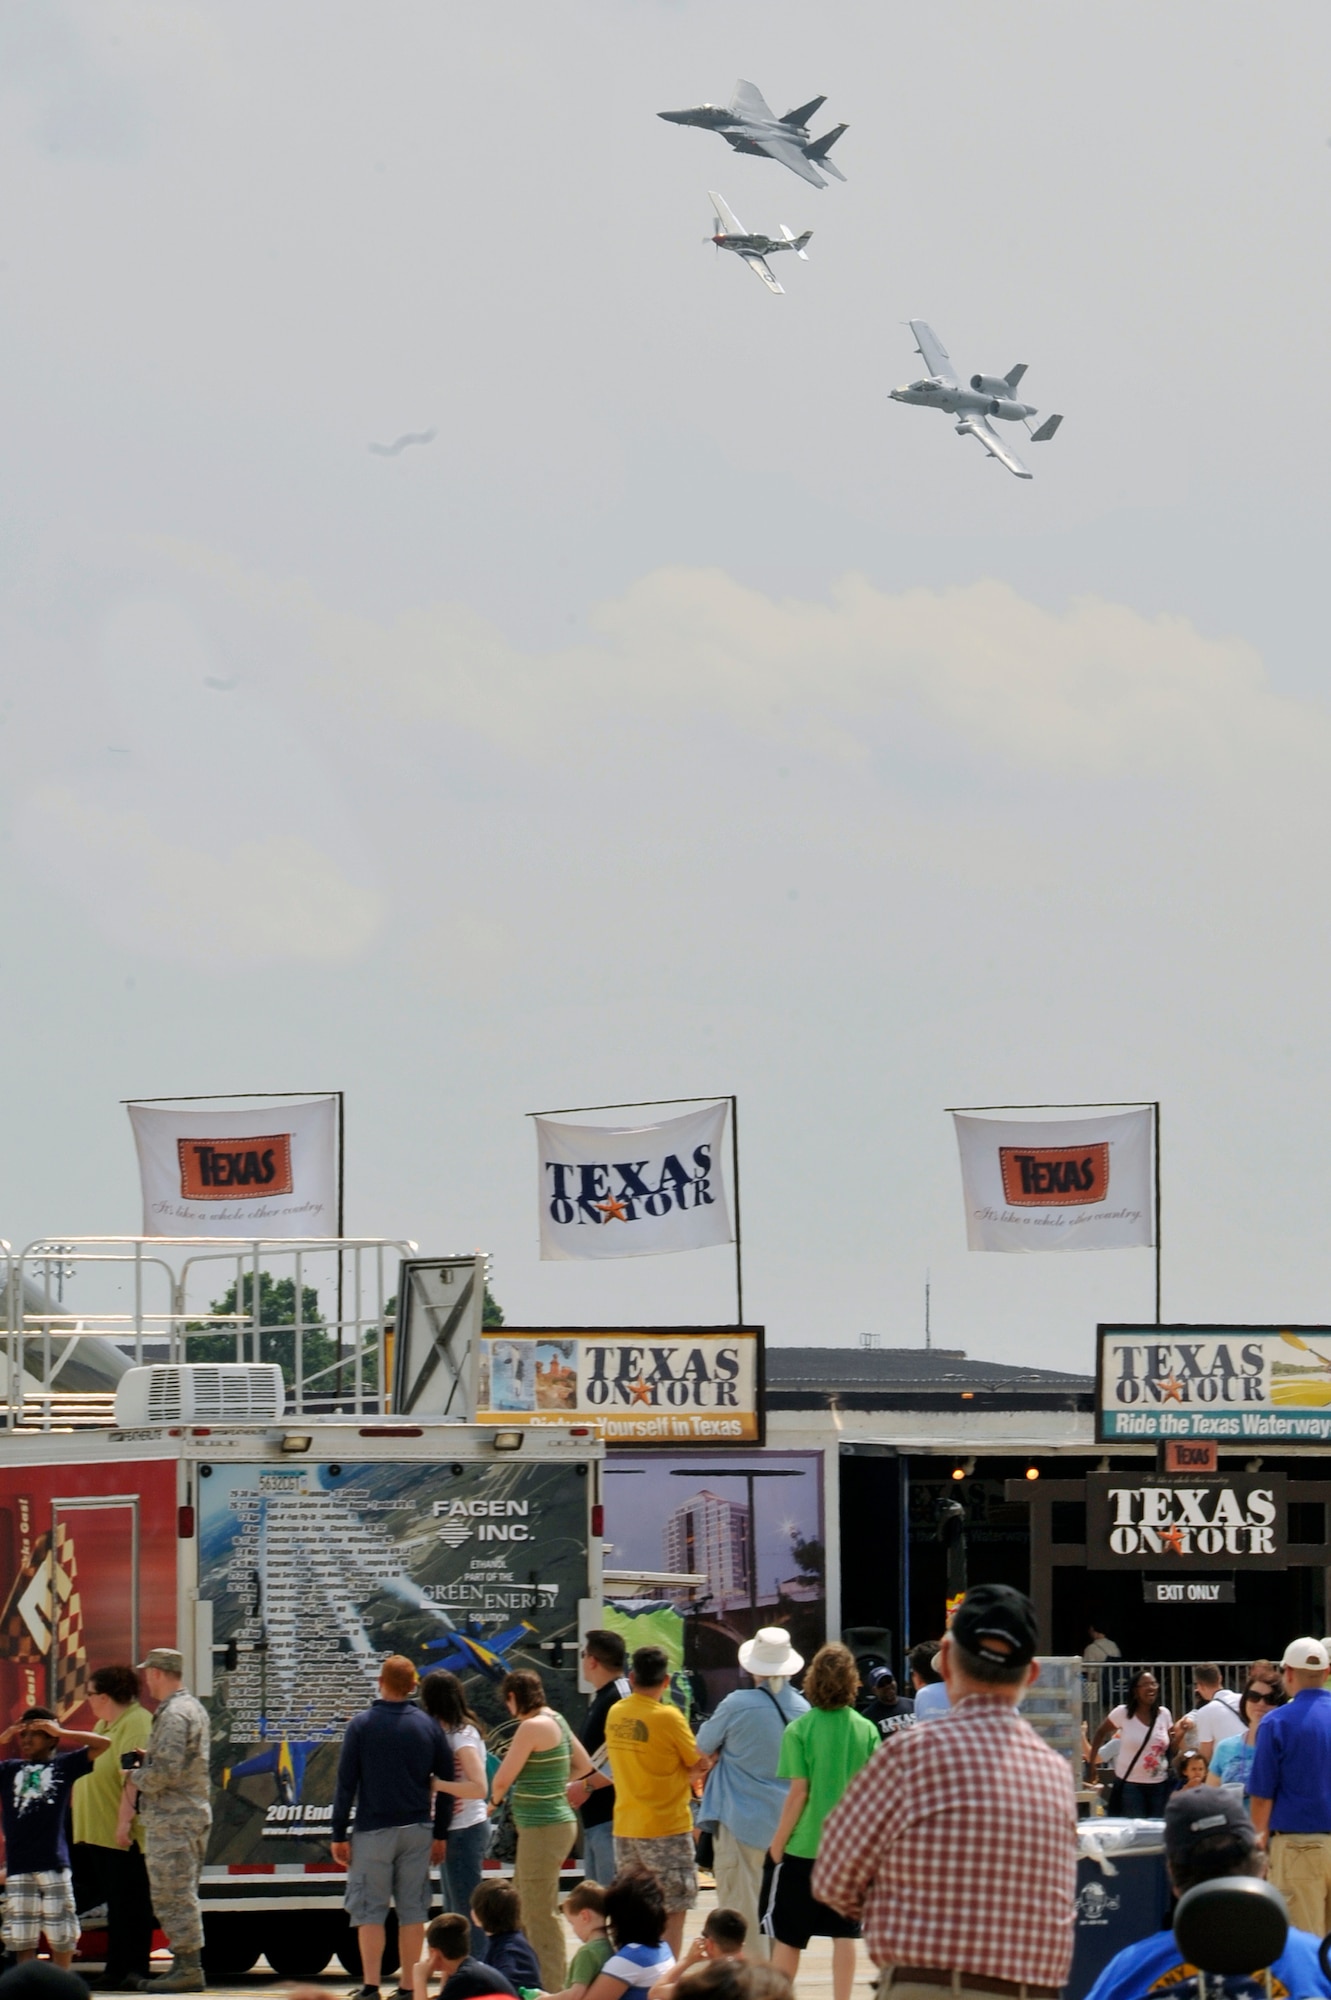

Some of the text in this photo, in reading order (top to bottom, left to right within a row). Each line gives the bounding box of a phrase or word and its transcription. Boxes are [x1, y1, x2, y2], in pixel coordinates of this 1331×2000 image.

[193, 1146, 277, 1187] TEXAS
[545, 1144, 712, 1201] TEXAS
[1014, 1155, 1096, 1195] TEXAS
[175, 1206, 195, 1220] like
[210, 1208, 245, 1221] whole
[248, 1205, 280, 1219] other
[550, 1179, 717, 1225] ON TOUR
[1000, 1209, 1021, 1224] like
[1023, 1217, 1031, 1225] a
[1034, 1212, 1065, 1227] whole
[1068, 1211, 1092, 1226] other
[585, 1346, 740, 1382] TEXAS
[1113, 1343, 1265, 1380] TEXAS
[586, 1379, 740, 1407] ON TOUR
[1116, 1374, 1266, 1404] ON TOUR
[597, 1416, 669, 1436] Yourself
[673, 1417, 690, 1436] in
[690, 1417, 743, 1436] Texas
[1115, 1413, 1158, 1434] Ride
[1159, 1414, 1189, 1434] the
[1191, 1414, 1241, 1434] Texas
[1174, 1445, 1210, 1465] TEXAS
[19, 1498, 30, 1534] Gas!
[433, 1500, 529, 1517] FAGEN
[1108, 1488, 1277, 1527] TEXAS
[478, 1524, 536, 1541] INC.
[1109, 1526, 1277, 1555] ON TOUR
[463, 1572, 515, 1582] PART OF THE
[421, 1584, 484, 1600] GREEN
[484, 1593, 559, 1609] ENERGY
[1157, 1584, 1220, 1601] EXIT ONLY
[25, 1669, 36, 1707] Gas!
[265, 1804, 303, 1821] 2011
